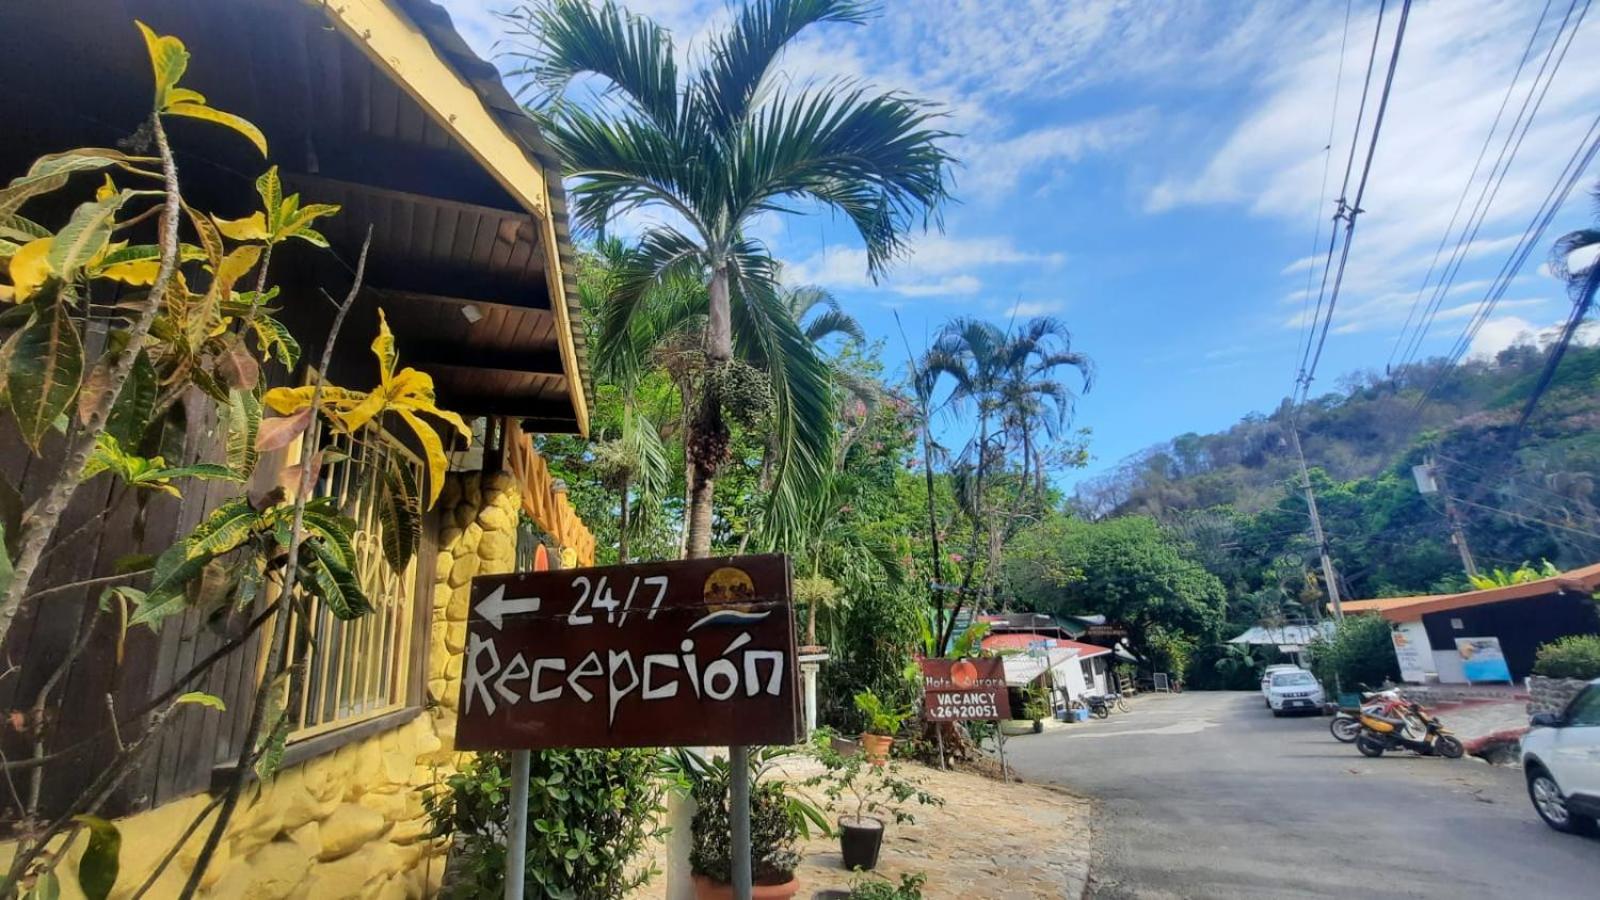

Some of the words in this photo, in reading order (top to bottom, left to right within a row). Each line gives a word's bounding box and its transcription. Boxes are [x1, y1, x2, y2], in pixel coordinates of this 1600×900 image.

[567, 576, 669, 627] 24/7
[464, 632, 785, 728] Recepción
[937, 693, 996, 705] VACANCY
[937, 705, 999, 718] 26420051
